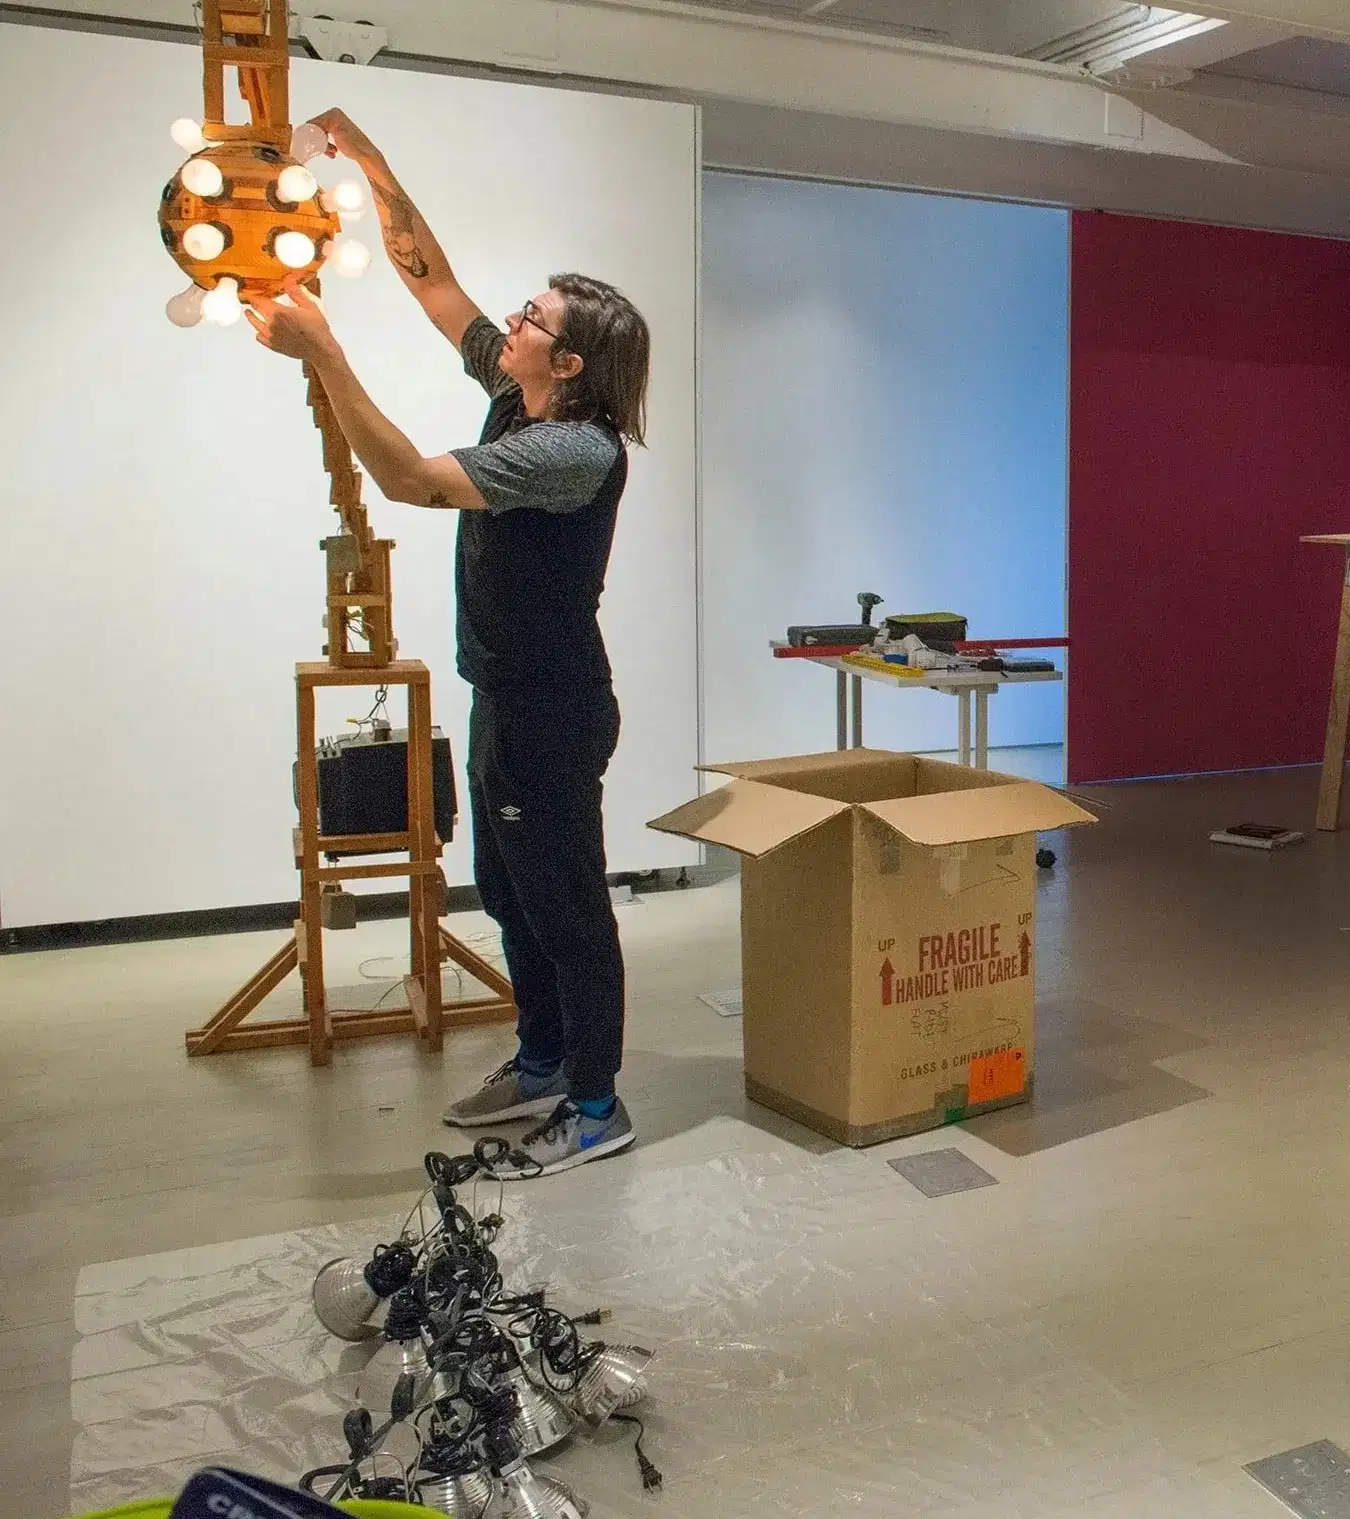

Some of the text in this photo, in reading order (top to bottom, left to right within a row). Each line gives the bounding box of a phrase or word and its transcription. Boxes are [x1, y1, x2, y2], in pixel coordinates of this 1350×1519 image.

[1017, 912, 1032, 925] UP
[877, 938, 896, 952] UP
[918, 922, 1001, 972] FRAGILE
[895, 955, 1018, 1005] HANDLE WITH CARE
[900, 1061, 936, 1080] GLASS
[941, 1059, 948, 1070] &
